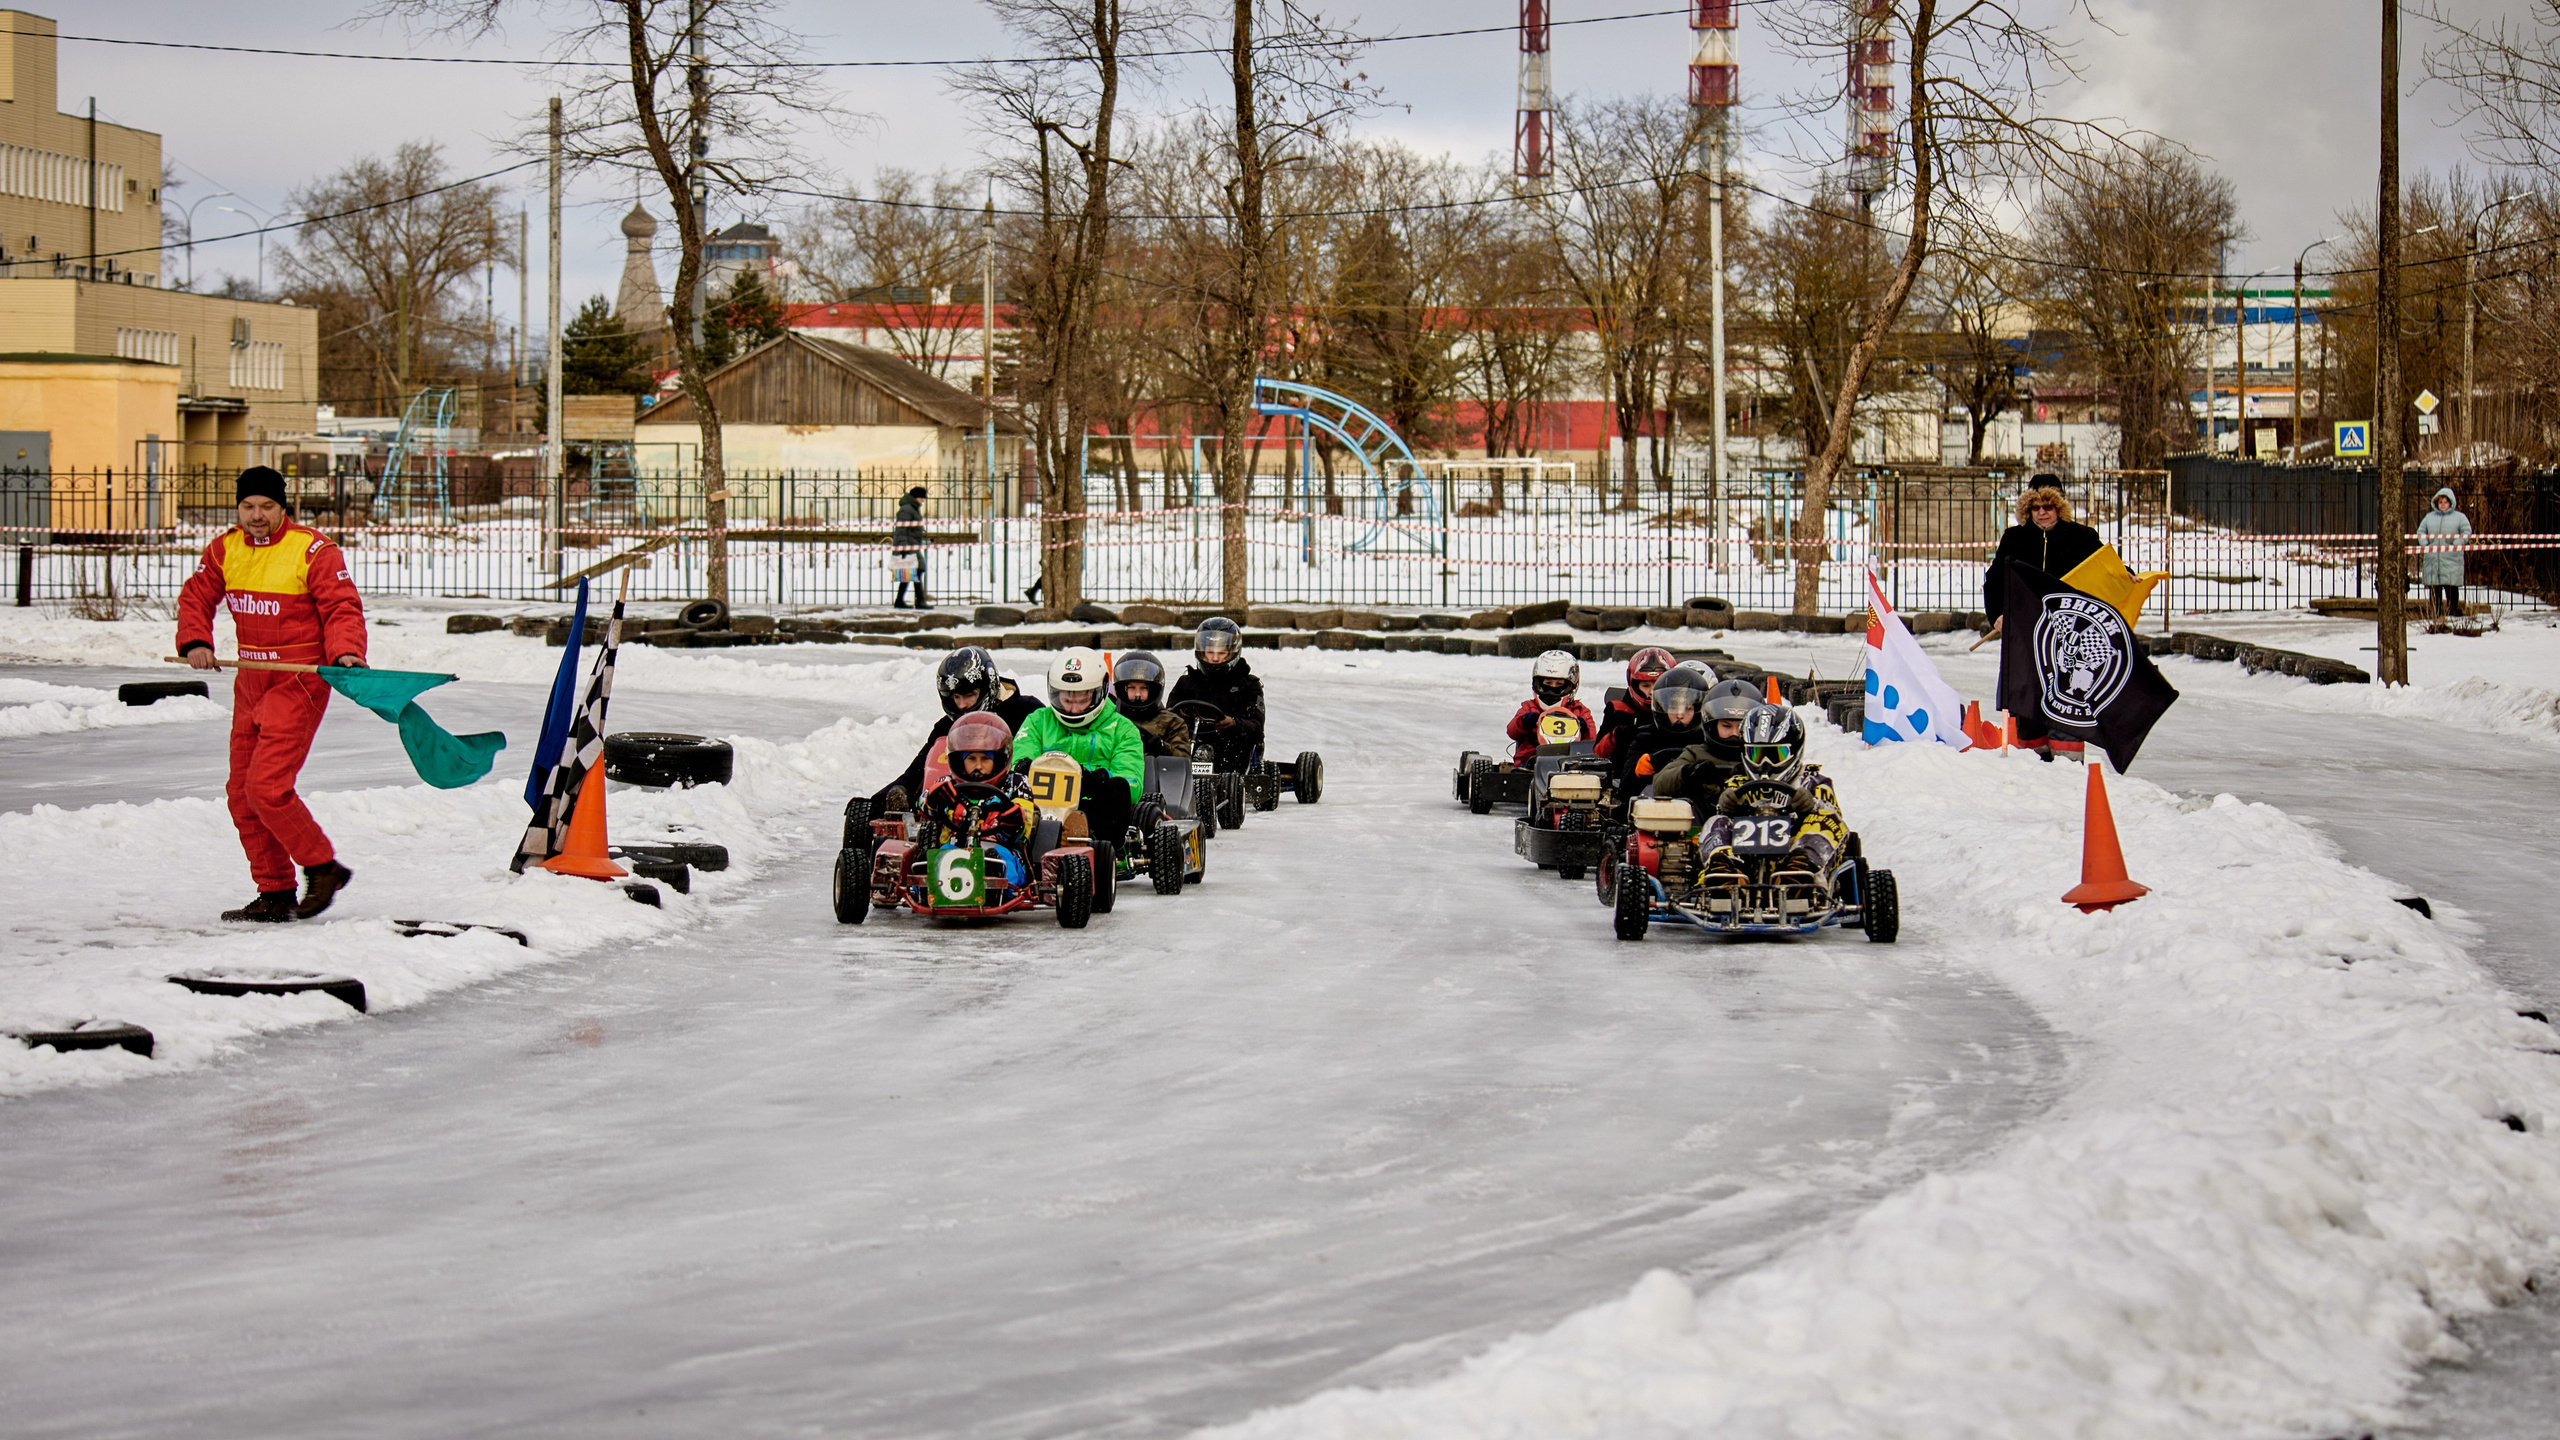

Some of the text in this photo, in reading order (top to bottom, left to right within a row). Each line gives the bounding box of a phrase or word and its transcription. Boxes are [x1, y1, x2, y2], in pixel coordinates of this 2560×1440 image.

[226, 592, 280, 616] Marlboro
[2060, 597, 2121, 636] ВИРАЖ
[2051, 699, 2073, 714] клуб
[1553, 720, 1566, 735] 3
[1033, 771, 1075, 802] 91
[1733, 819, 1790, 847] 213
[938, 848, 975, 901] 6
